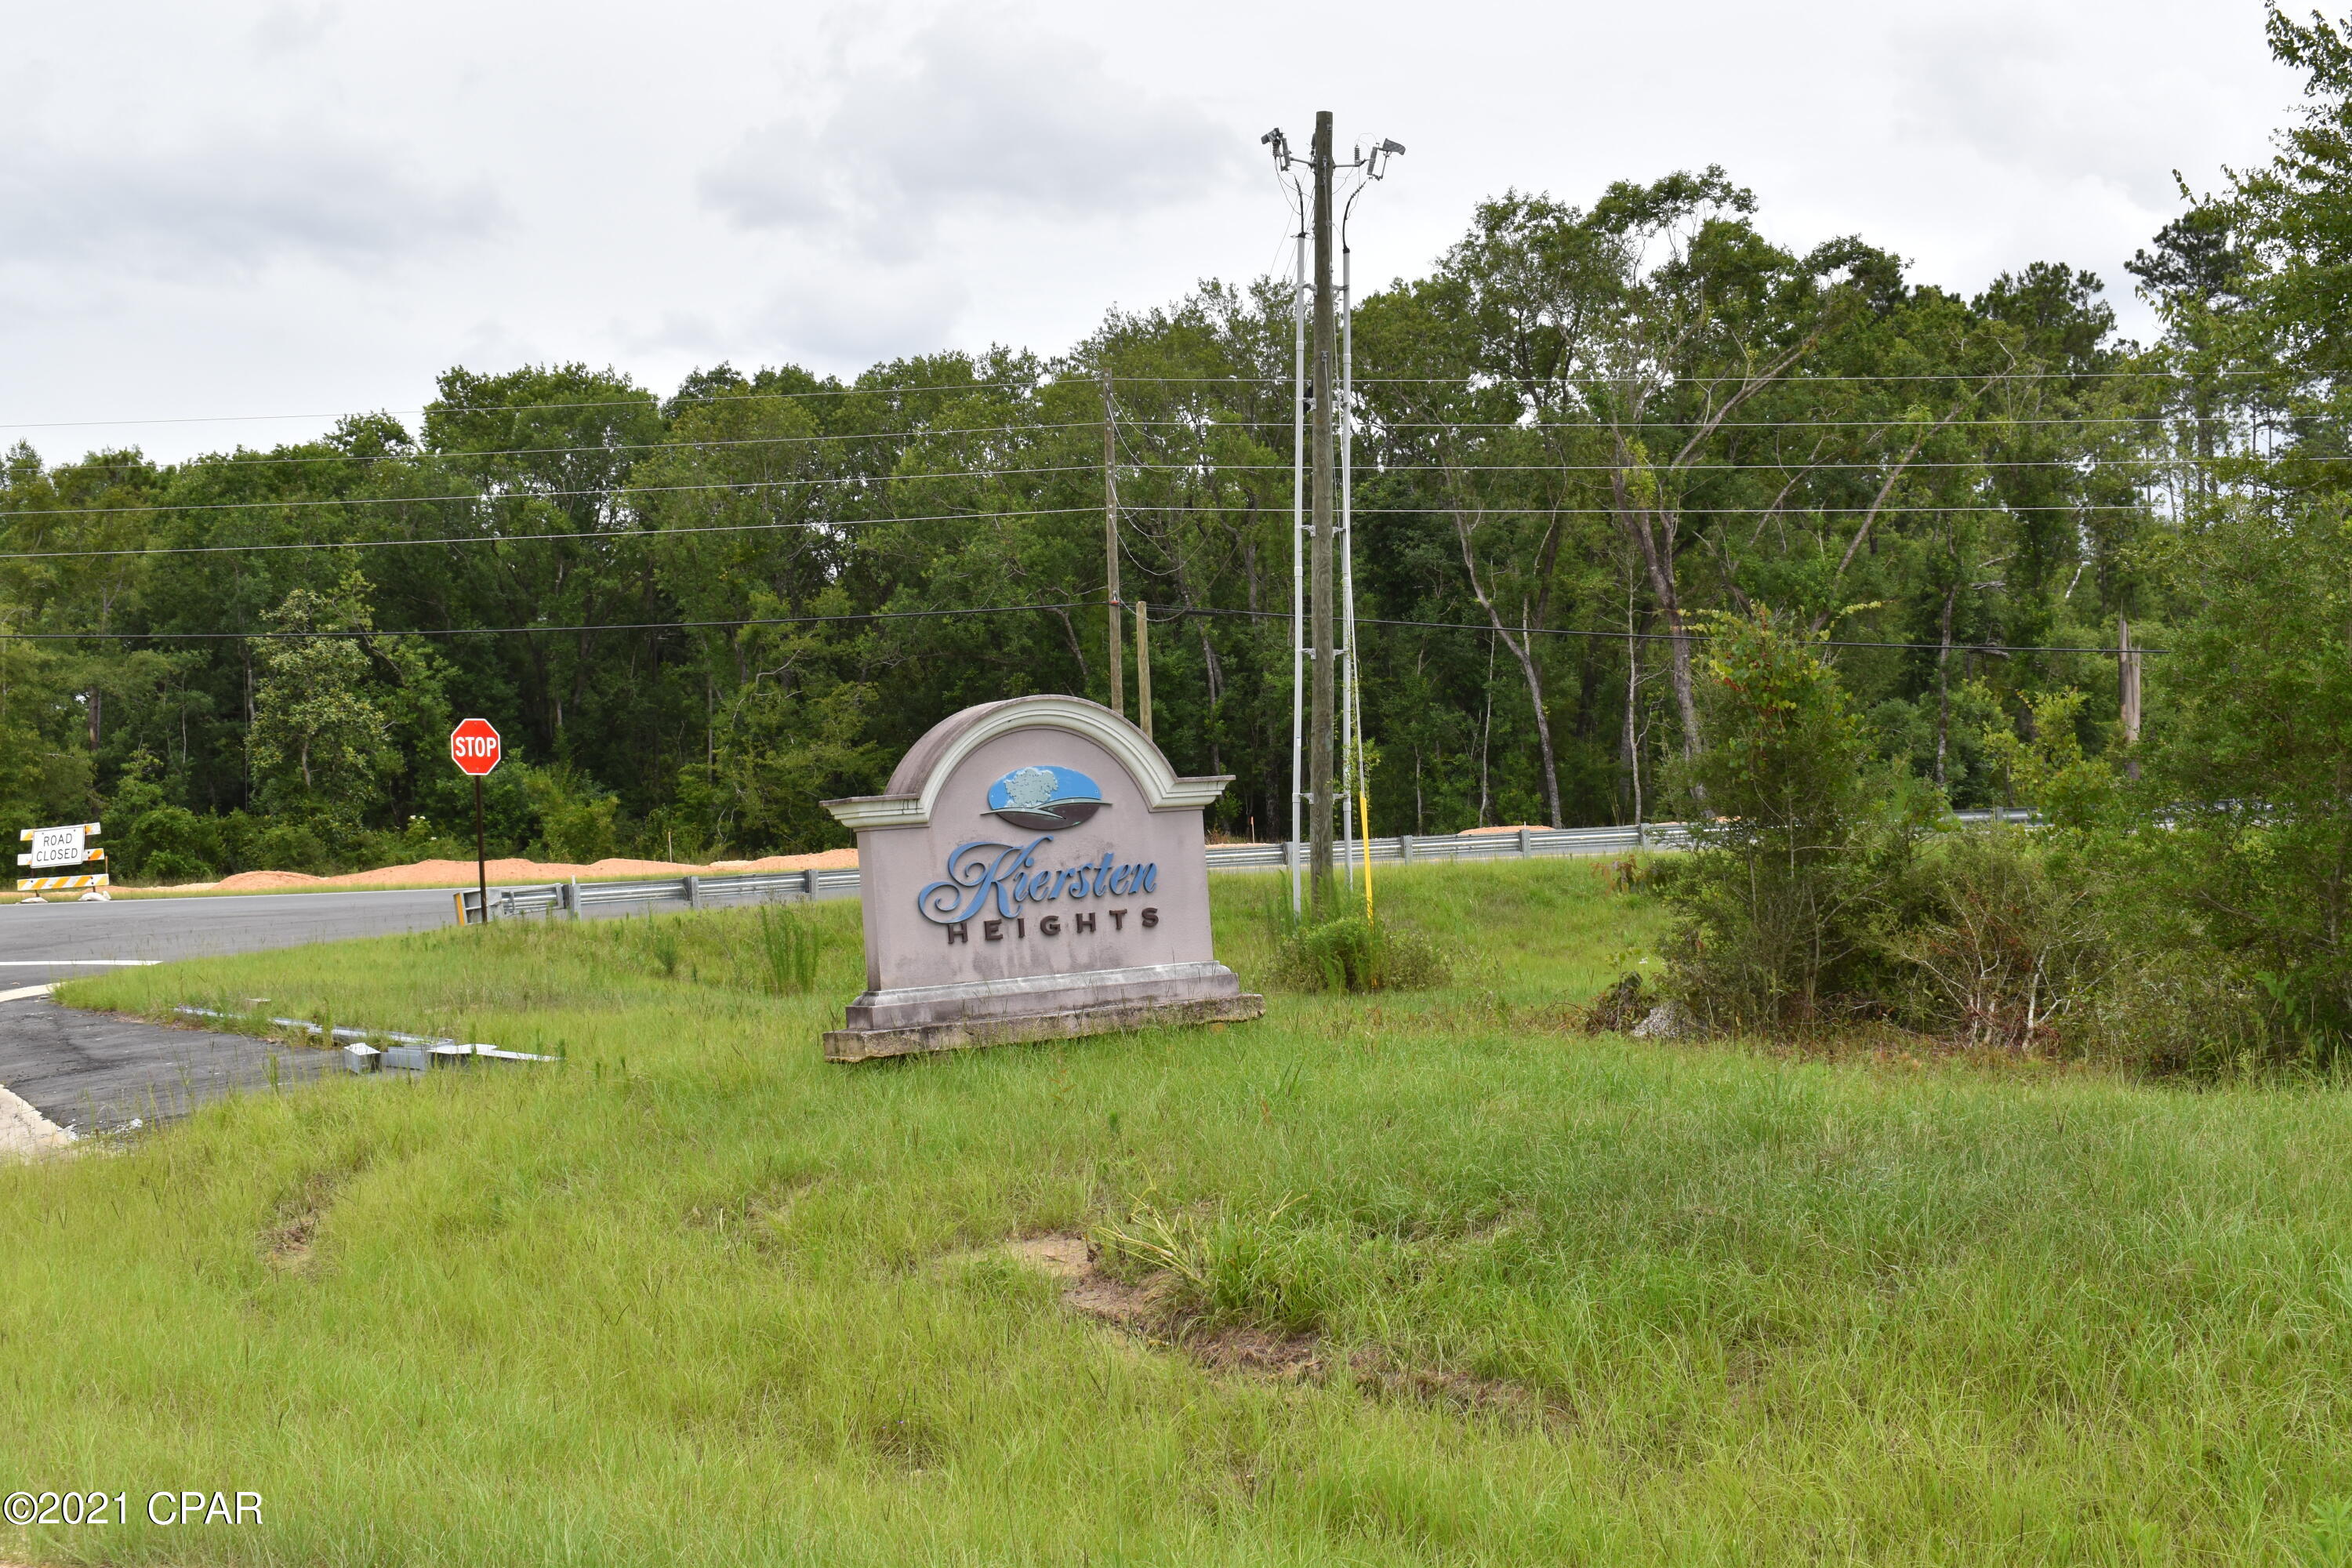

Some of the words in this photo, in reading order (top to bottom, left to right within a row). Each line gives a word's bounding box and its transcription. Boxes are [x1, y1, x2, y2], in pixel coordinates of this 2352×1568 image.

[455, 736, 497, 757] STOP
[43, 833, 73, 847] ROAD
[36, 848, 78, 862] CLOSED
[918, 835, 1158, 924] Kiersten
[947, 907, 1160, 945] HEIGHTS
